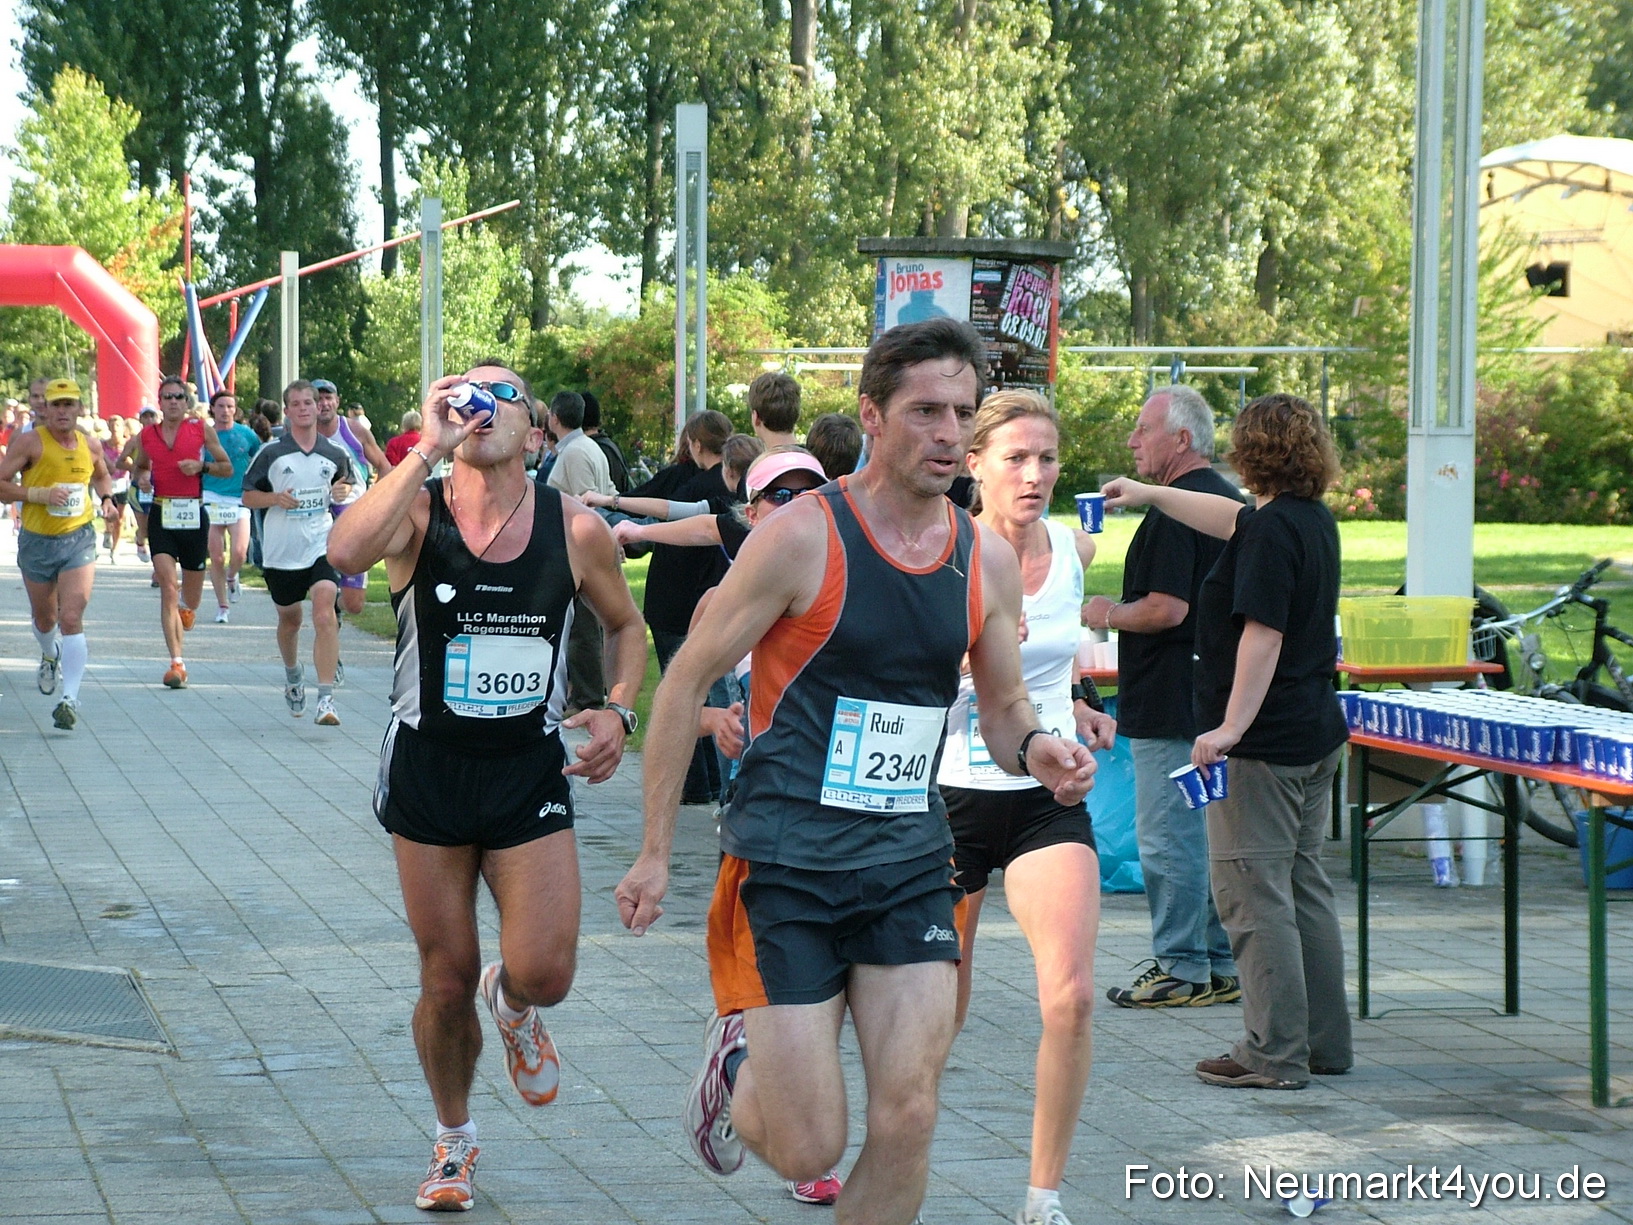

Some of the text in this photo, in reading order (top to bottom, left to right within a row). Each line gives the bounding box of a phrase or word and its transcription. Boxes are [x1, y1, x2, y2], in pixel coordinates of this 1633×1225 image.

[1007, 285, 1052, 331] ROCK
[1001, 312, 1048, 350] 08.09.07
[300, 498, 324, 509] 2354
[176, 512, 194, 520] 423
[219, 511, 236, 519] 1003
[457, 612, 547, 624] LLC Marathon
[463, 623, 540, 636] Regensburg
[476, 672, 541, 695] 3603
[870, 712, 905, 736] Rudi
[834, 739, 844, 755] A
[865, 751, 927, 782] 2340
[824, 789, 872, 805] BOCK
